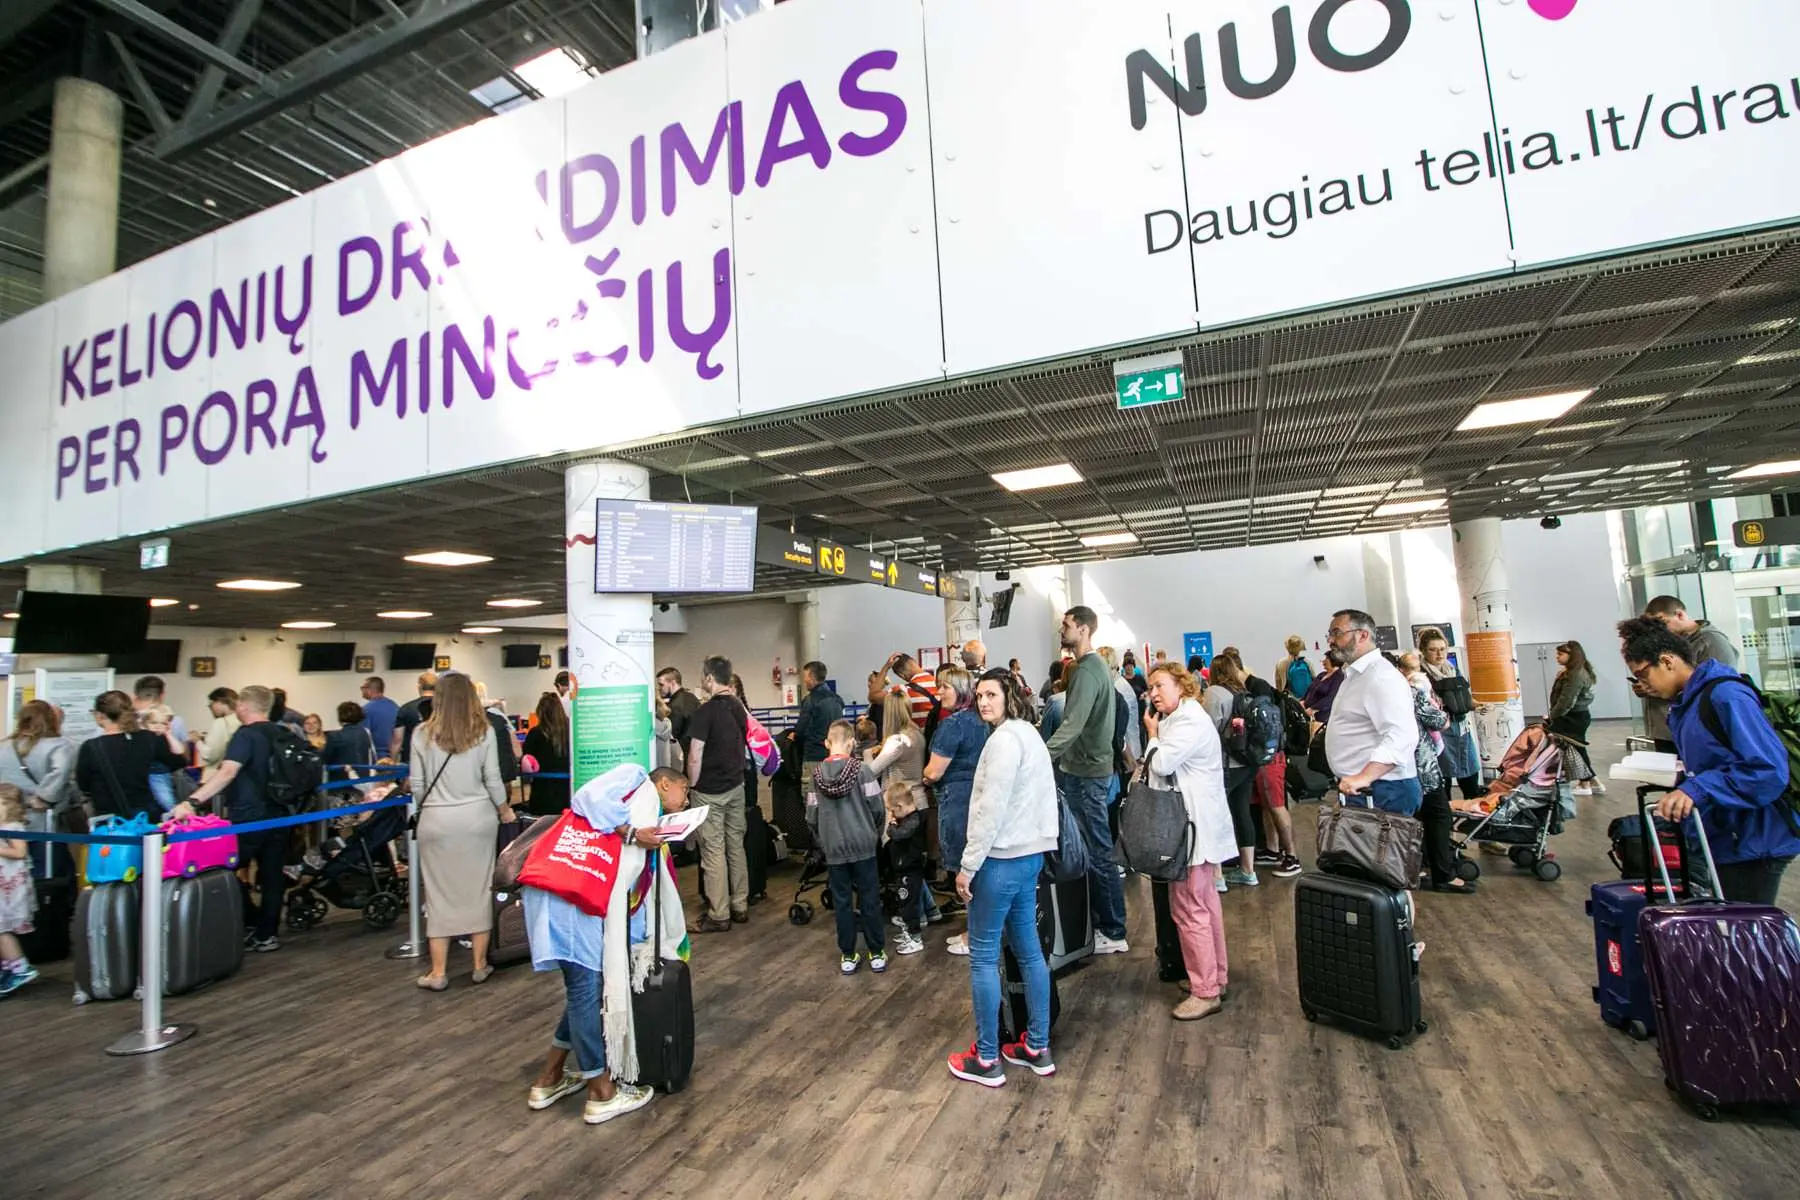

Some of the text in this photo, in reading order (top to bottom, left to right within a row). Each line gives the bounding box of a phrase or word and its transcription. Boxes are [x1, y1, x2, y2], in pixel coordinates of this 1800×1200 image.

[1125, 0, 1411, 131] NUO
[60, 50, 907, 407] KELIONIŲ DRDIMAS
[1144, 168, 1393, 255] Daugiau
[57, 417, 141, 501] PER
[159, 365, 327, 463] PORĄ
